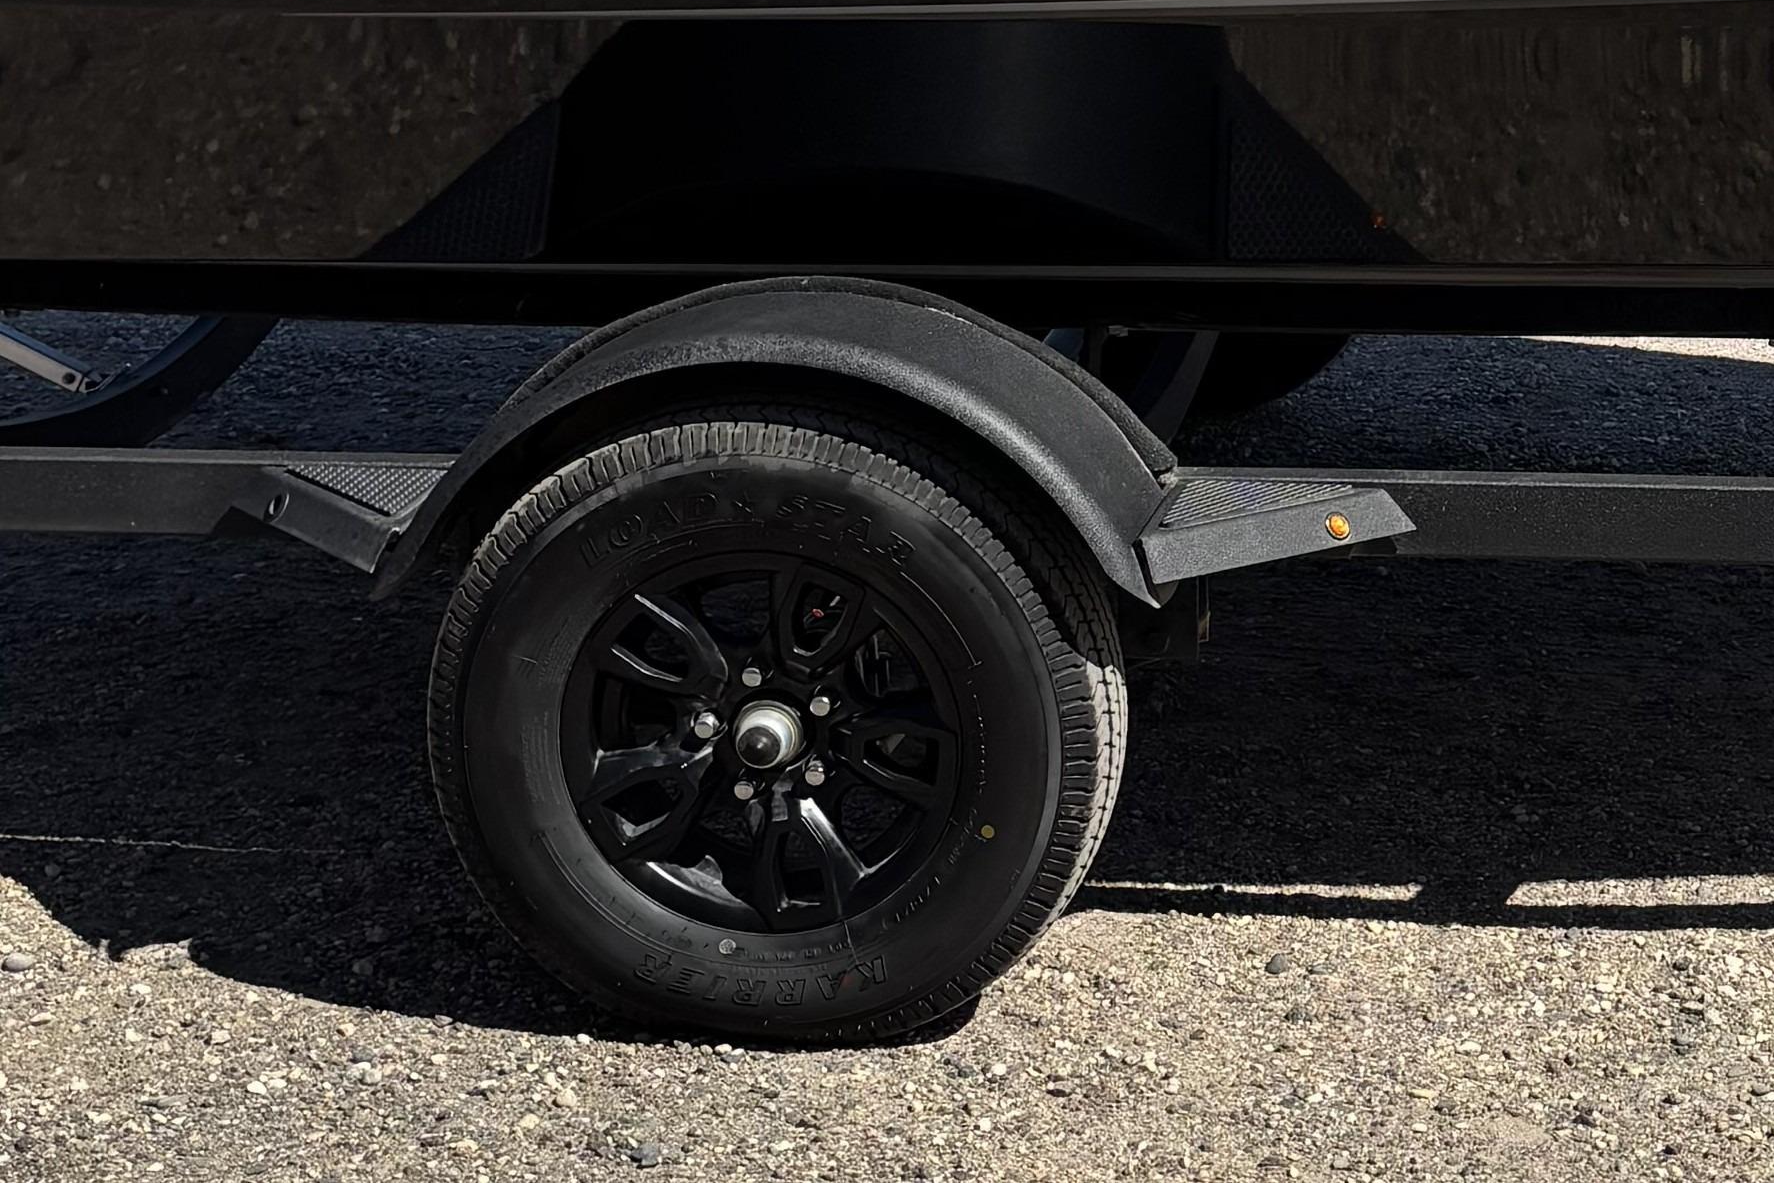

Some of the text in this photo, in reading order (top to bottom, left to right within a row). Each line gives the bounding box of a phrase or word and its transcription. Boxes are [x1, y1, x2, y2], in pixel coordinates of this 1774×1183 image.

[579, 489, 918, 569] LOAD STAR
[632, 953, 888, 1008] KARRIER
